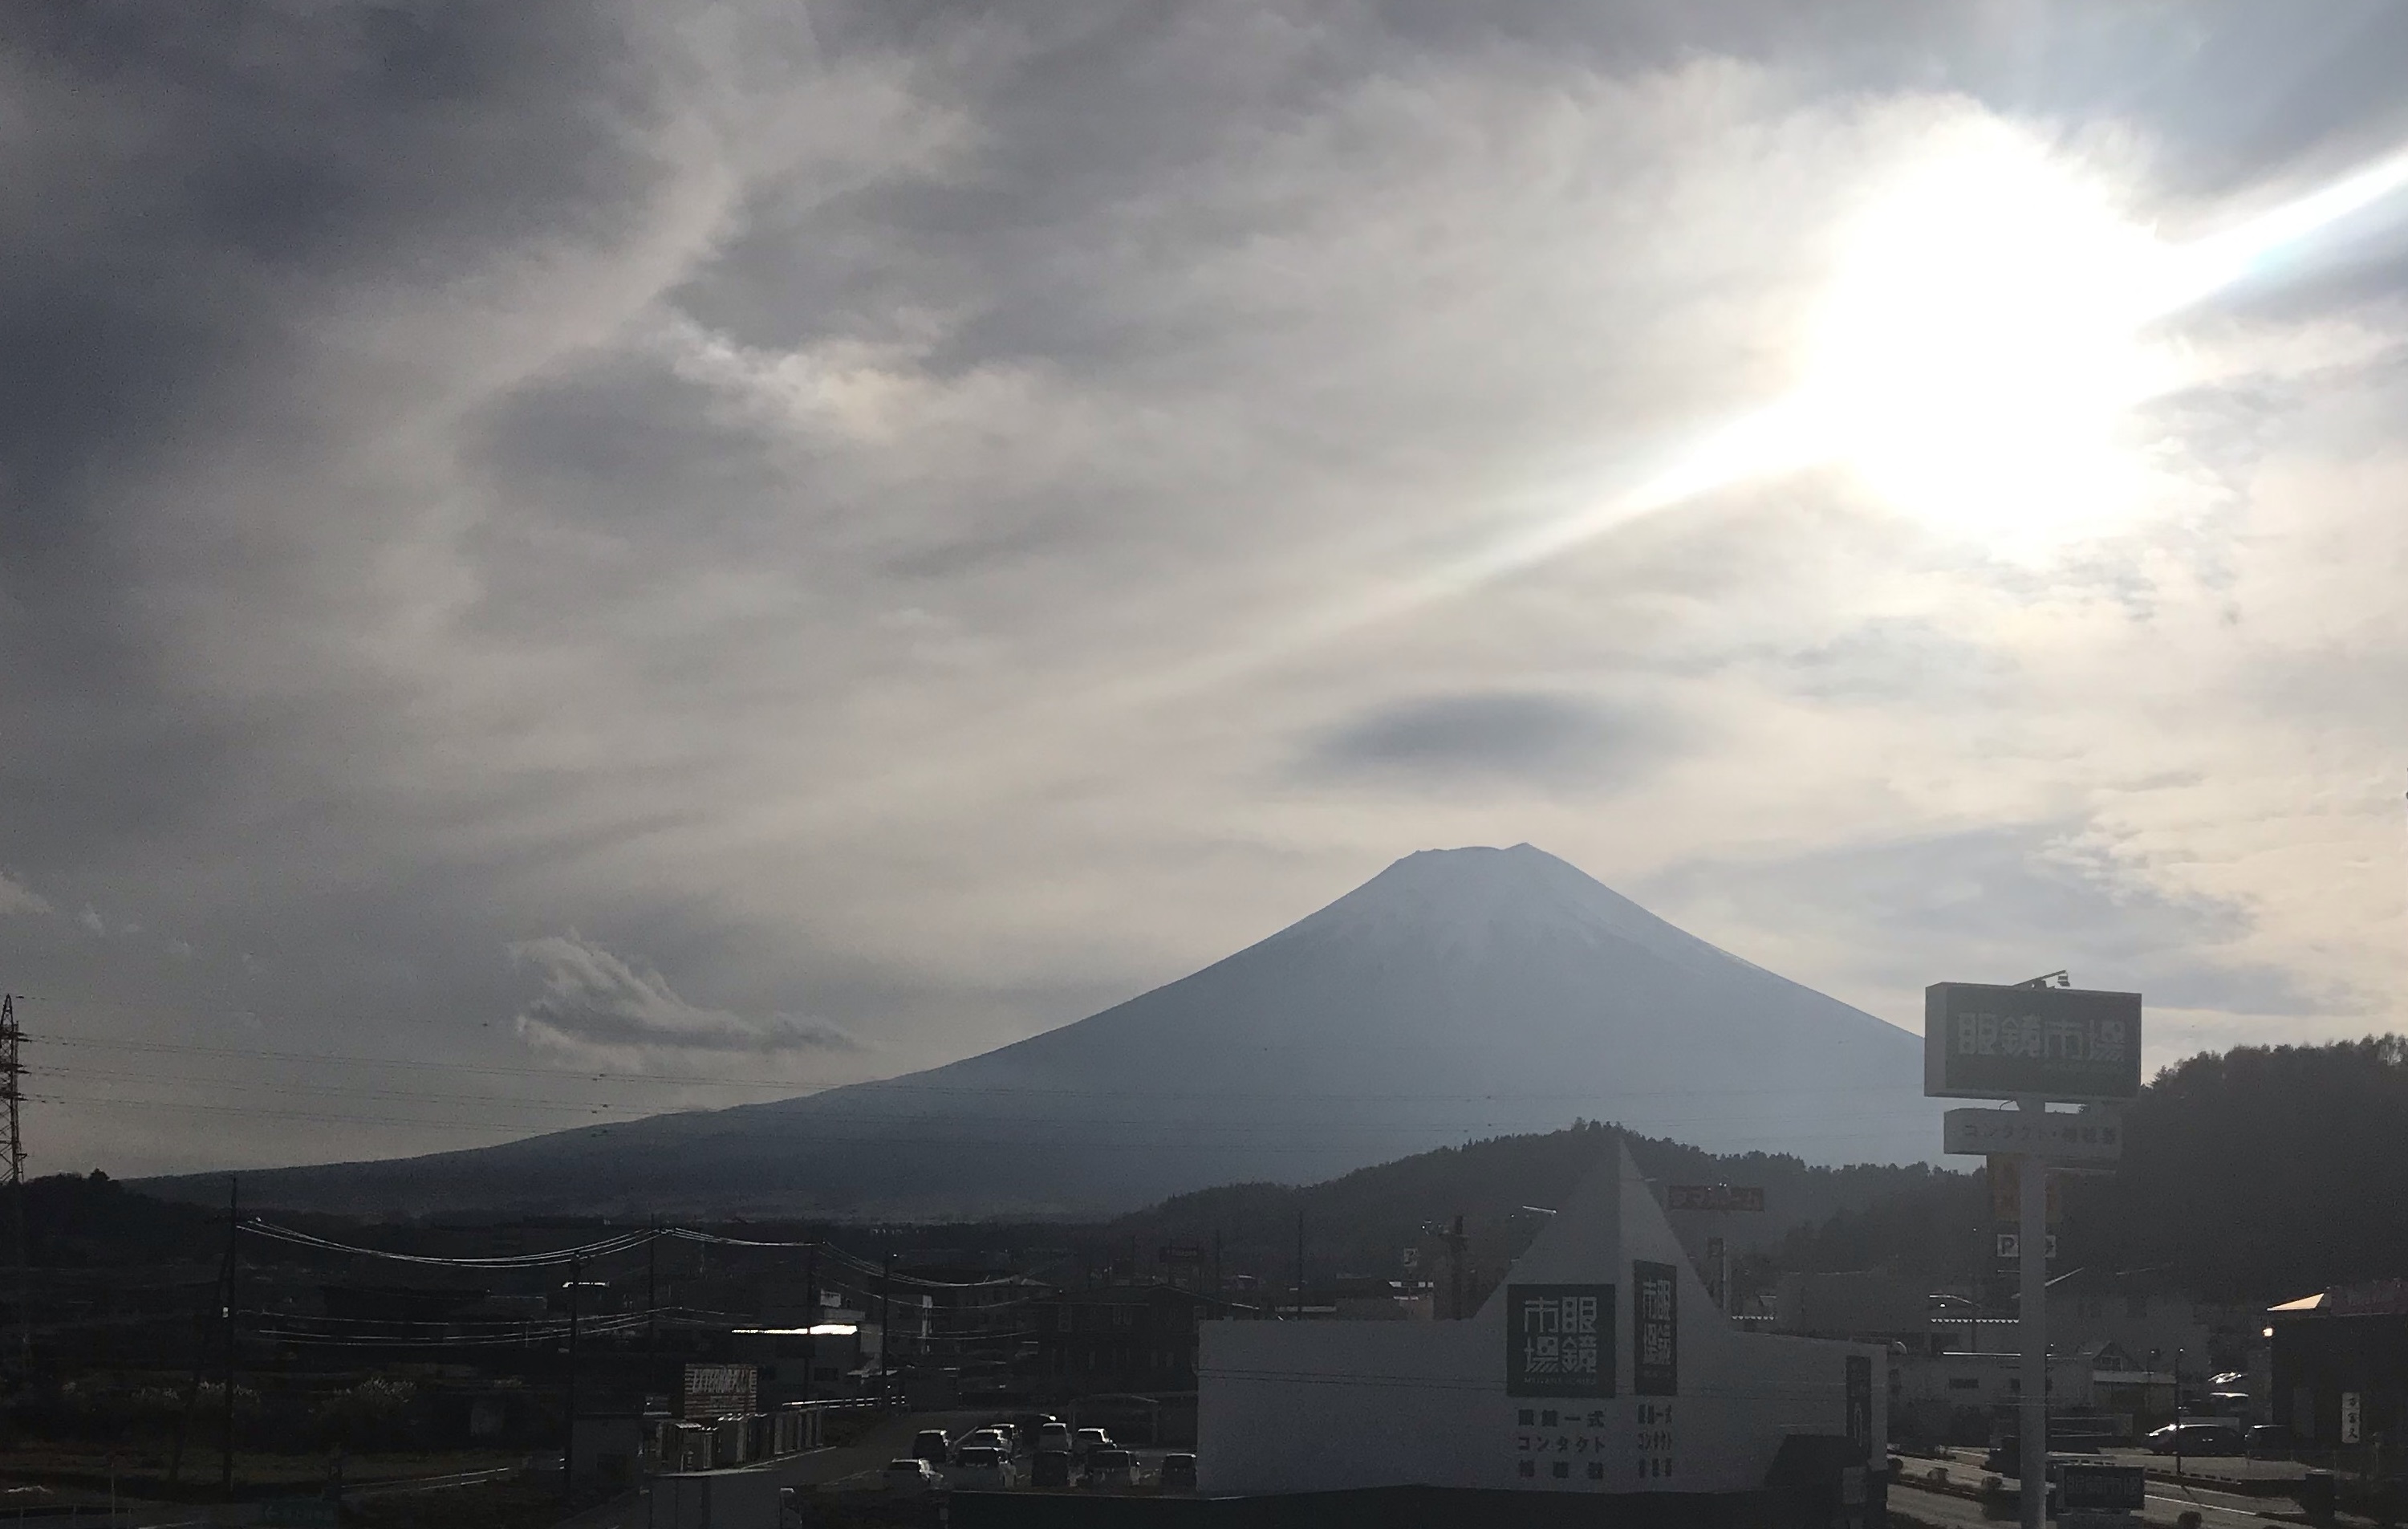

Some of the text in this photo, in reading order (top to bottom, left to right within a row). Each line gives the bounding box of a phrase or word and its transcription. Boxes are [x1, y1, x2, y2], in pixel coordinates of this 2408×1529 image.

[1958, 1011, 2126, 1062] 眼鏡市場
[2001, 1237, 2015, 1255] P
[1518, 1435, 1605, 1454] コンタクト
